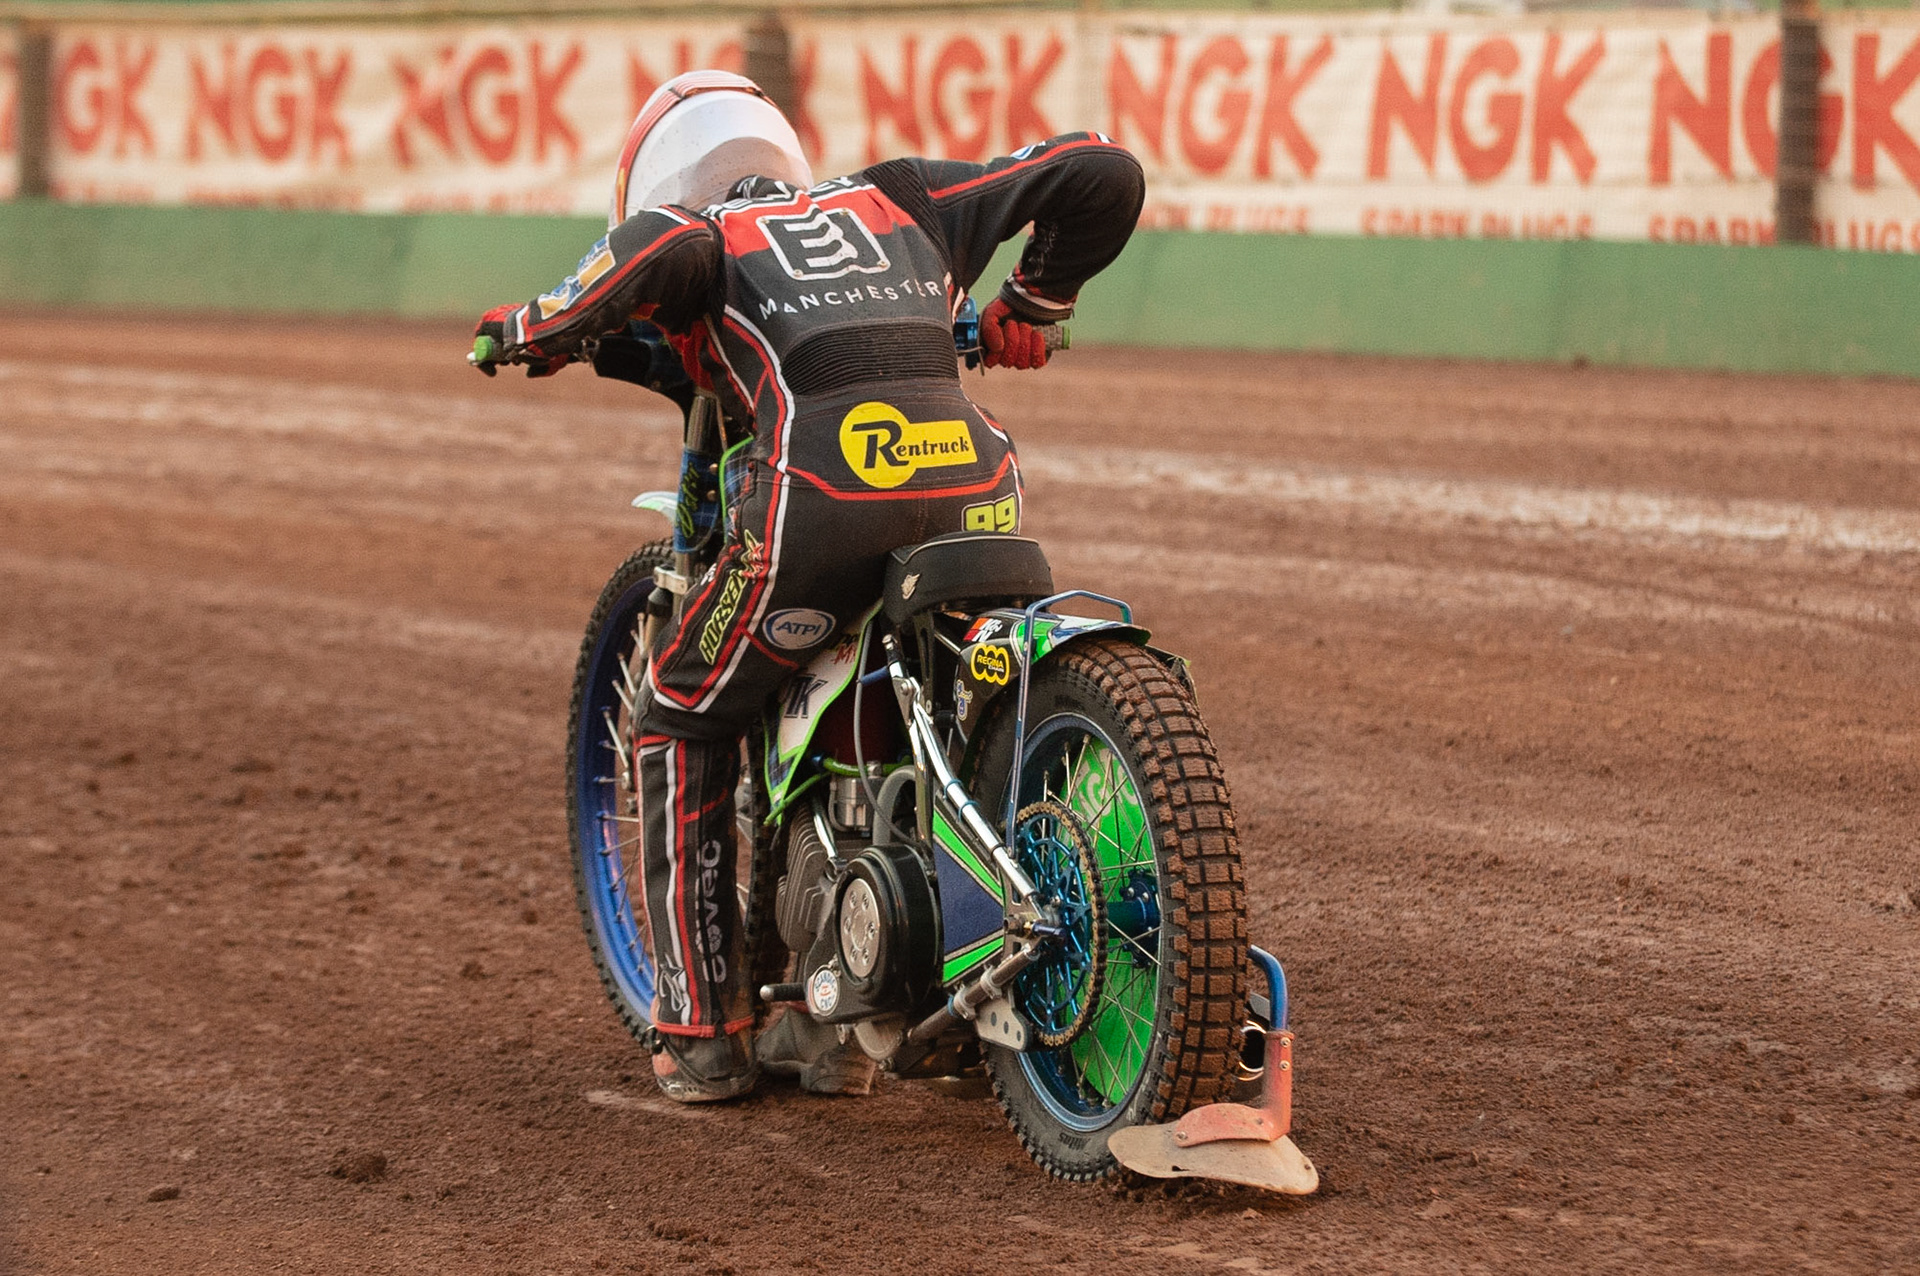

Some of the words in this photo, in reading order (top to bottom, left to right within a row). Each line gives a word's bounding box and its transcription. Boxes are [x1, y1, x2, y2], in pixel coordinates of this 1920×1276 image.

[32, 42, 155, 161] GK
[187, 41, 351, 164] NGK
[394, 40, 584, 166] NGK
[857, 32, 1066, 163] NGK
[1108, 33, 1335, 181] NGK
[1366, 31, 1607, 187] NGK
[1648, 32, 1920, 193] NGK
[758, 278, 942, 320] MANCHESTER
[851, 419, 970, 469] Rentruck
[965, 494, 1017, 534] 99
[775, 621, 822, 636] ATPI
[977, 654, 1005, 669] REGINA
